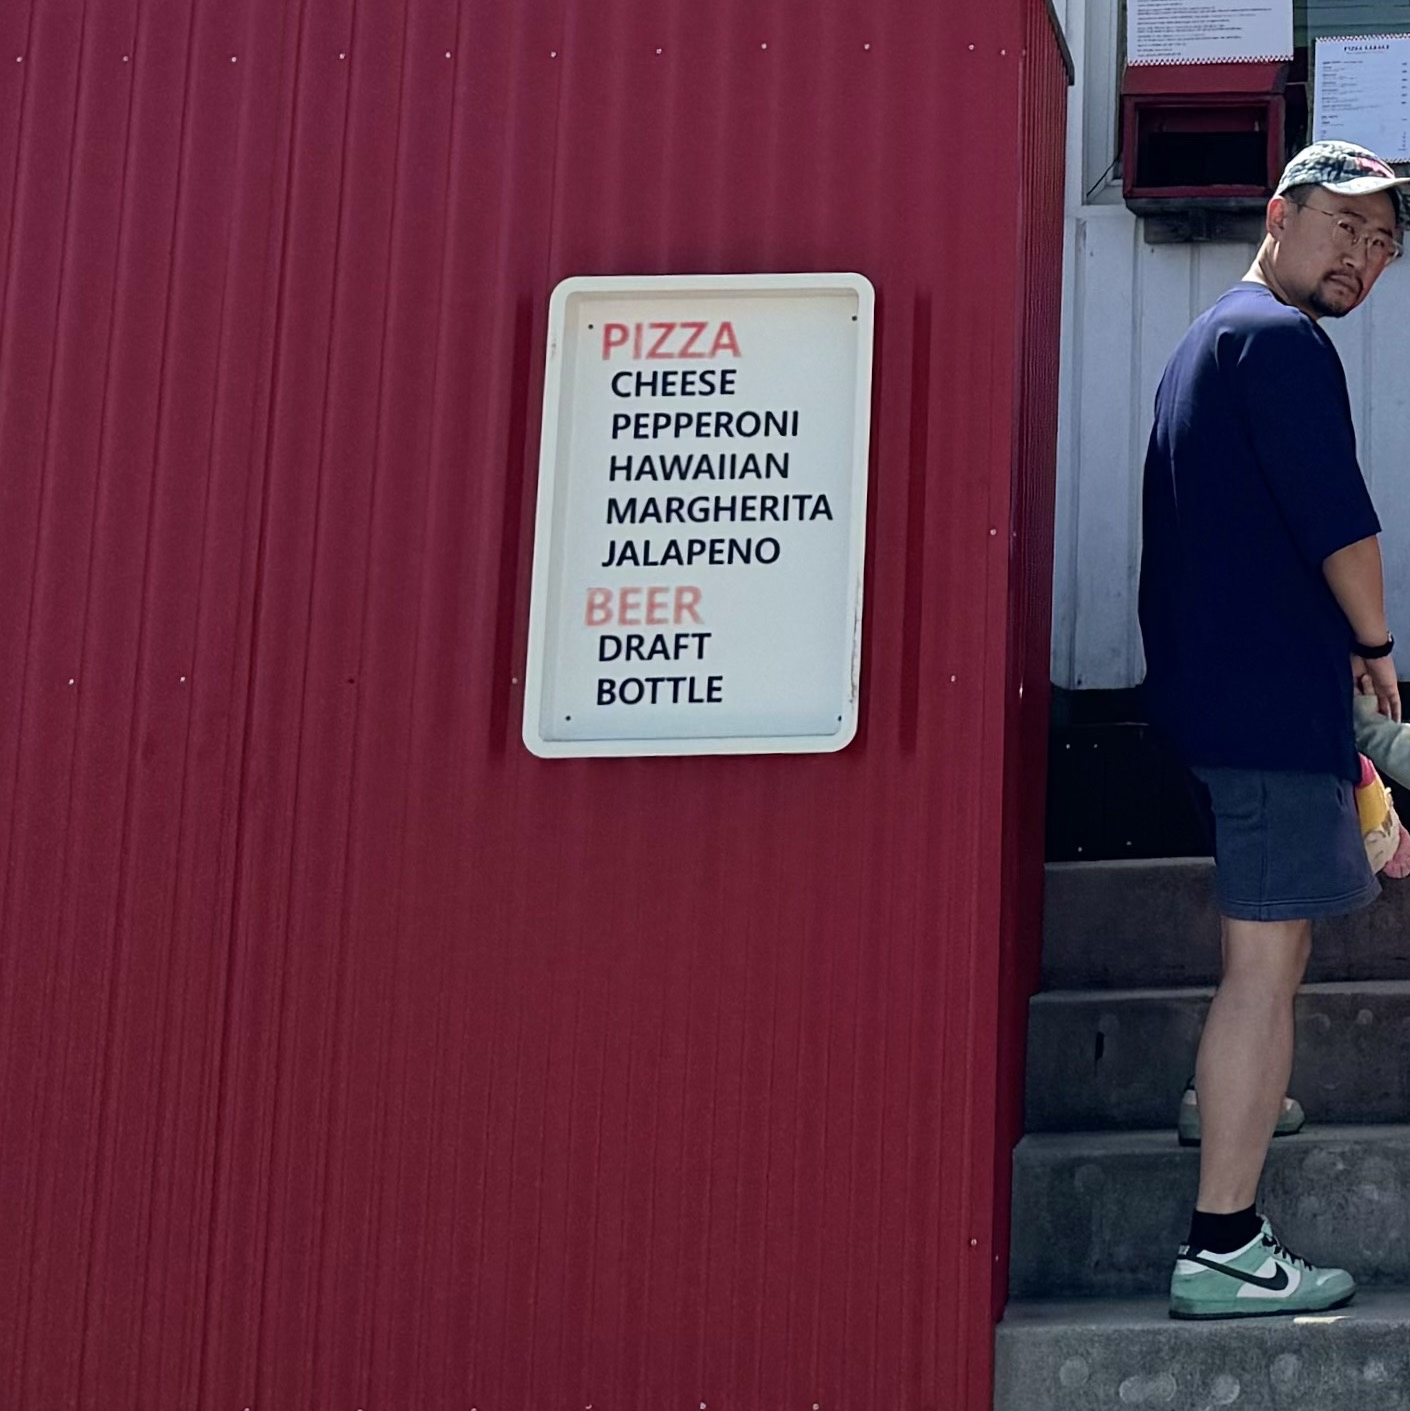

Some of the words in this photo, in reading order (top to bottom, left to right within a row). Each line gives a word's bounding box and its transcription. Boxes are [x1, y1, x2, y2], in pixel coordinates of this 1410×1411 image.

[601, 321, 742, 360] PIZZA
[610, 369, 737, 398] CHEESE
[611, 410, 799, 440] PEPPERONI
[608, 452, 790, 482] HAWAIIAN
[606, 493, 833, 525] MARGHERITA
[601, 537, 781, 568] JALAPENO
[584, 585, 704, 627] BEER
[598, 632, 712, 662] DRAFT
[596, 675, 723, 706] BOTTLE
